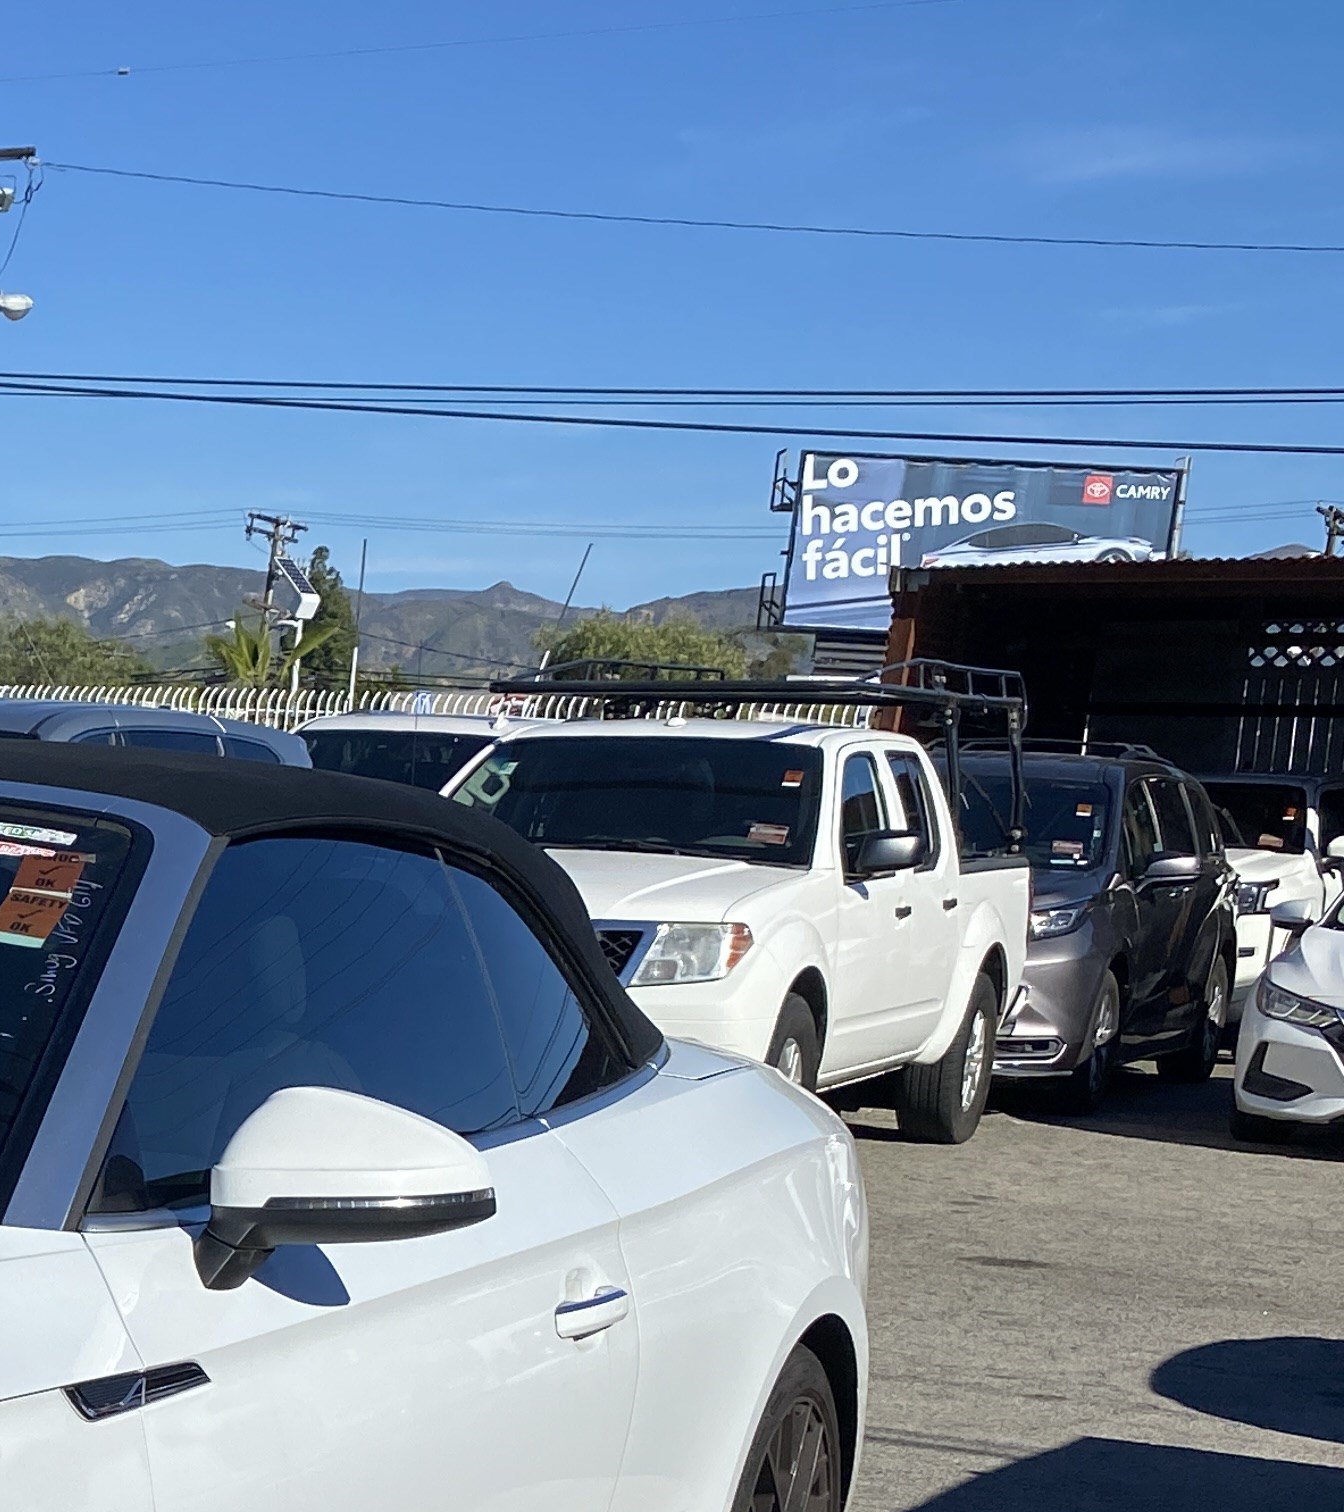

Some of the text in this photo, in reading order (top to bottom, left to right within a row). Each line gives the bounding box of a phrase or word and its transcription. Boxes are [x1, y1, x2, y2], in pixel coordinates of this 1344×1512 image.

[801, 453, 860, 491] Lo
[1114, 483, 1172, 502] CAMRY
[800, 490, 1018, 536] hacemos
[34, 876, 58, 889] OK
[10, 893, 68, 909] SAFETY
[8, 921, 33, 934] OK
